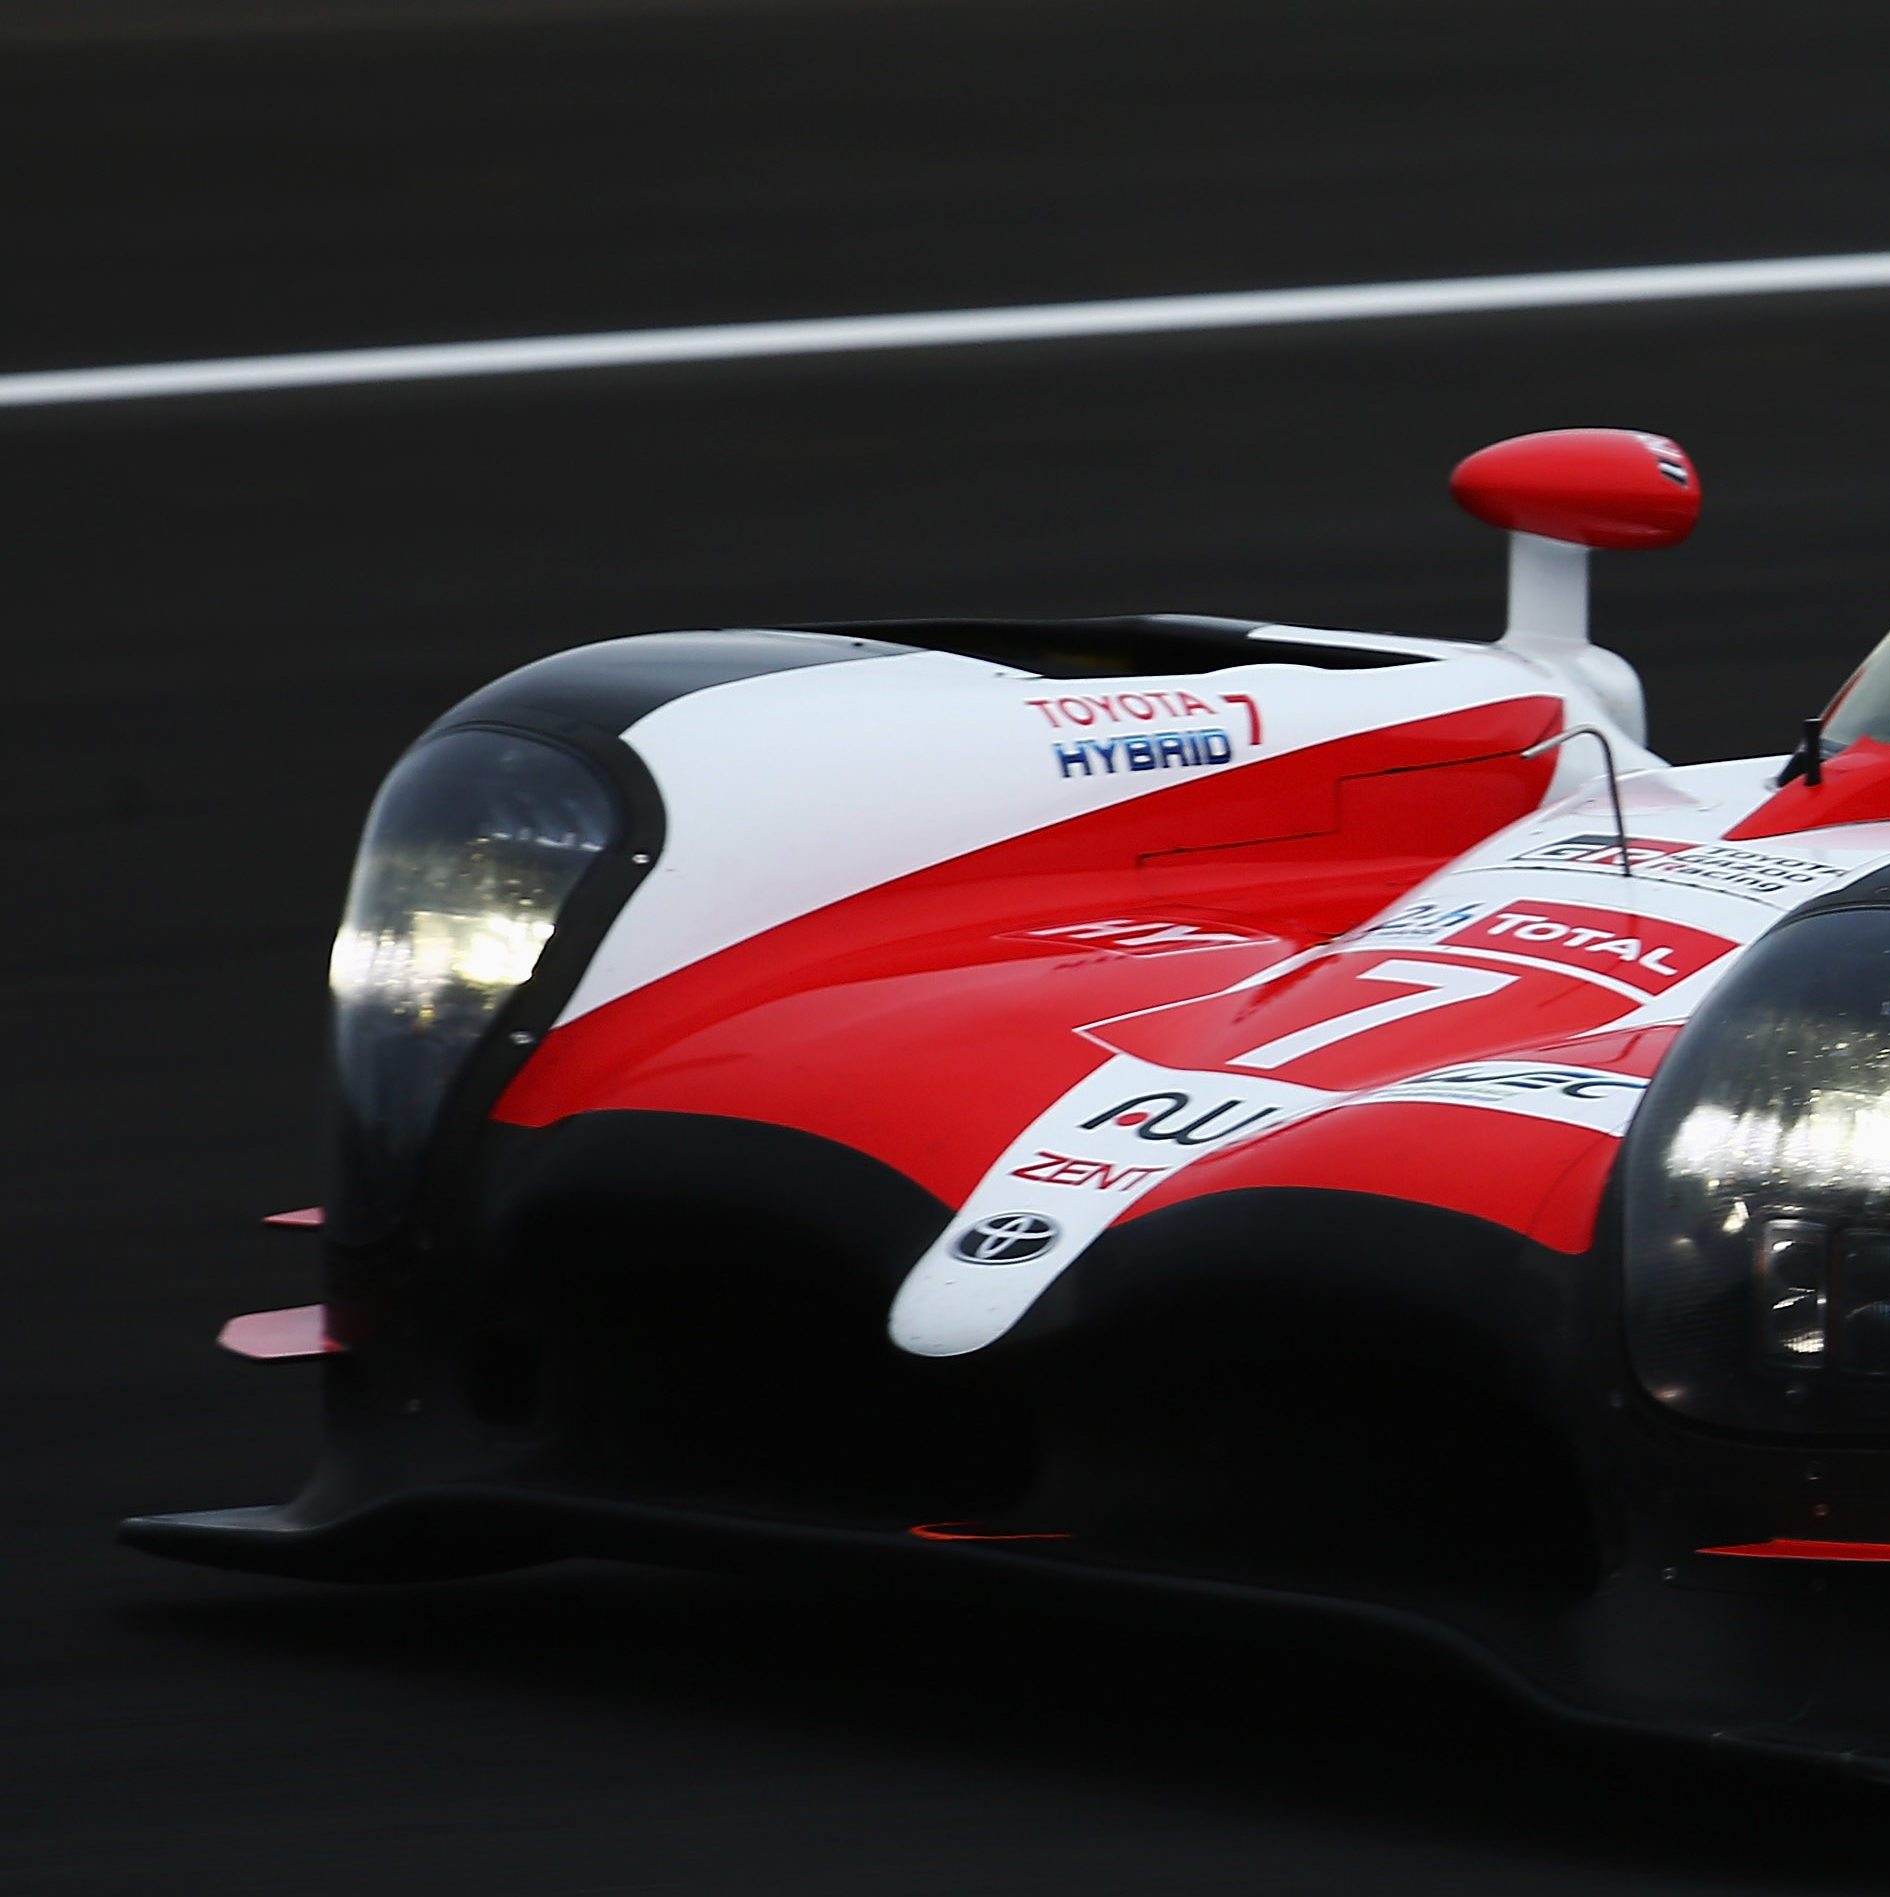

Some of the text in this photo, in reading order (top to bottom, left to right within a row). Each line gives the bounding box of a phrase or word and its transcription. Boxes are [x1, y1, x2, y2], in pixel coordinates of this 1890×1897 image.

[1025, 691, 1263, 746] TOYOTA 7
[1052, 729, 1232, 778] HYBRID
[1645, 861, 1785, 892] Racing
[1670, 854, 1814, 883] GAZOO
[1708, 846, 1848, 877] TOYOTA
[1026, 919, 1250, 946] HY
[1487, 912, 1678, 976] TOTAL
[1225, 959, 1520, 1069] 7
[1009, 1151, 1172, 1191] ZENT
